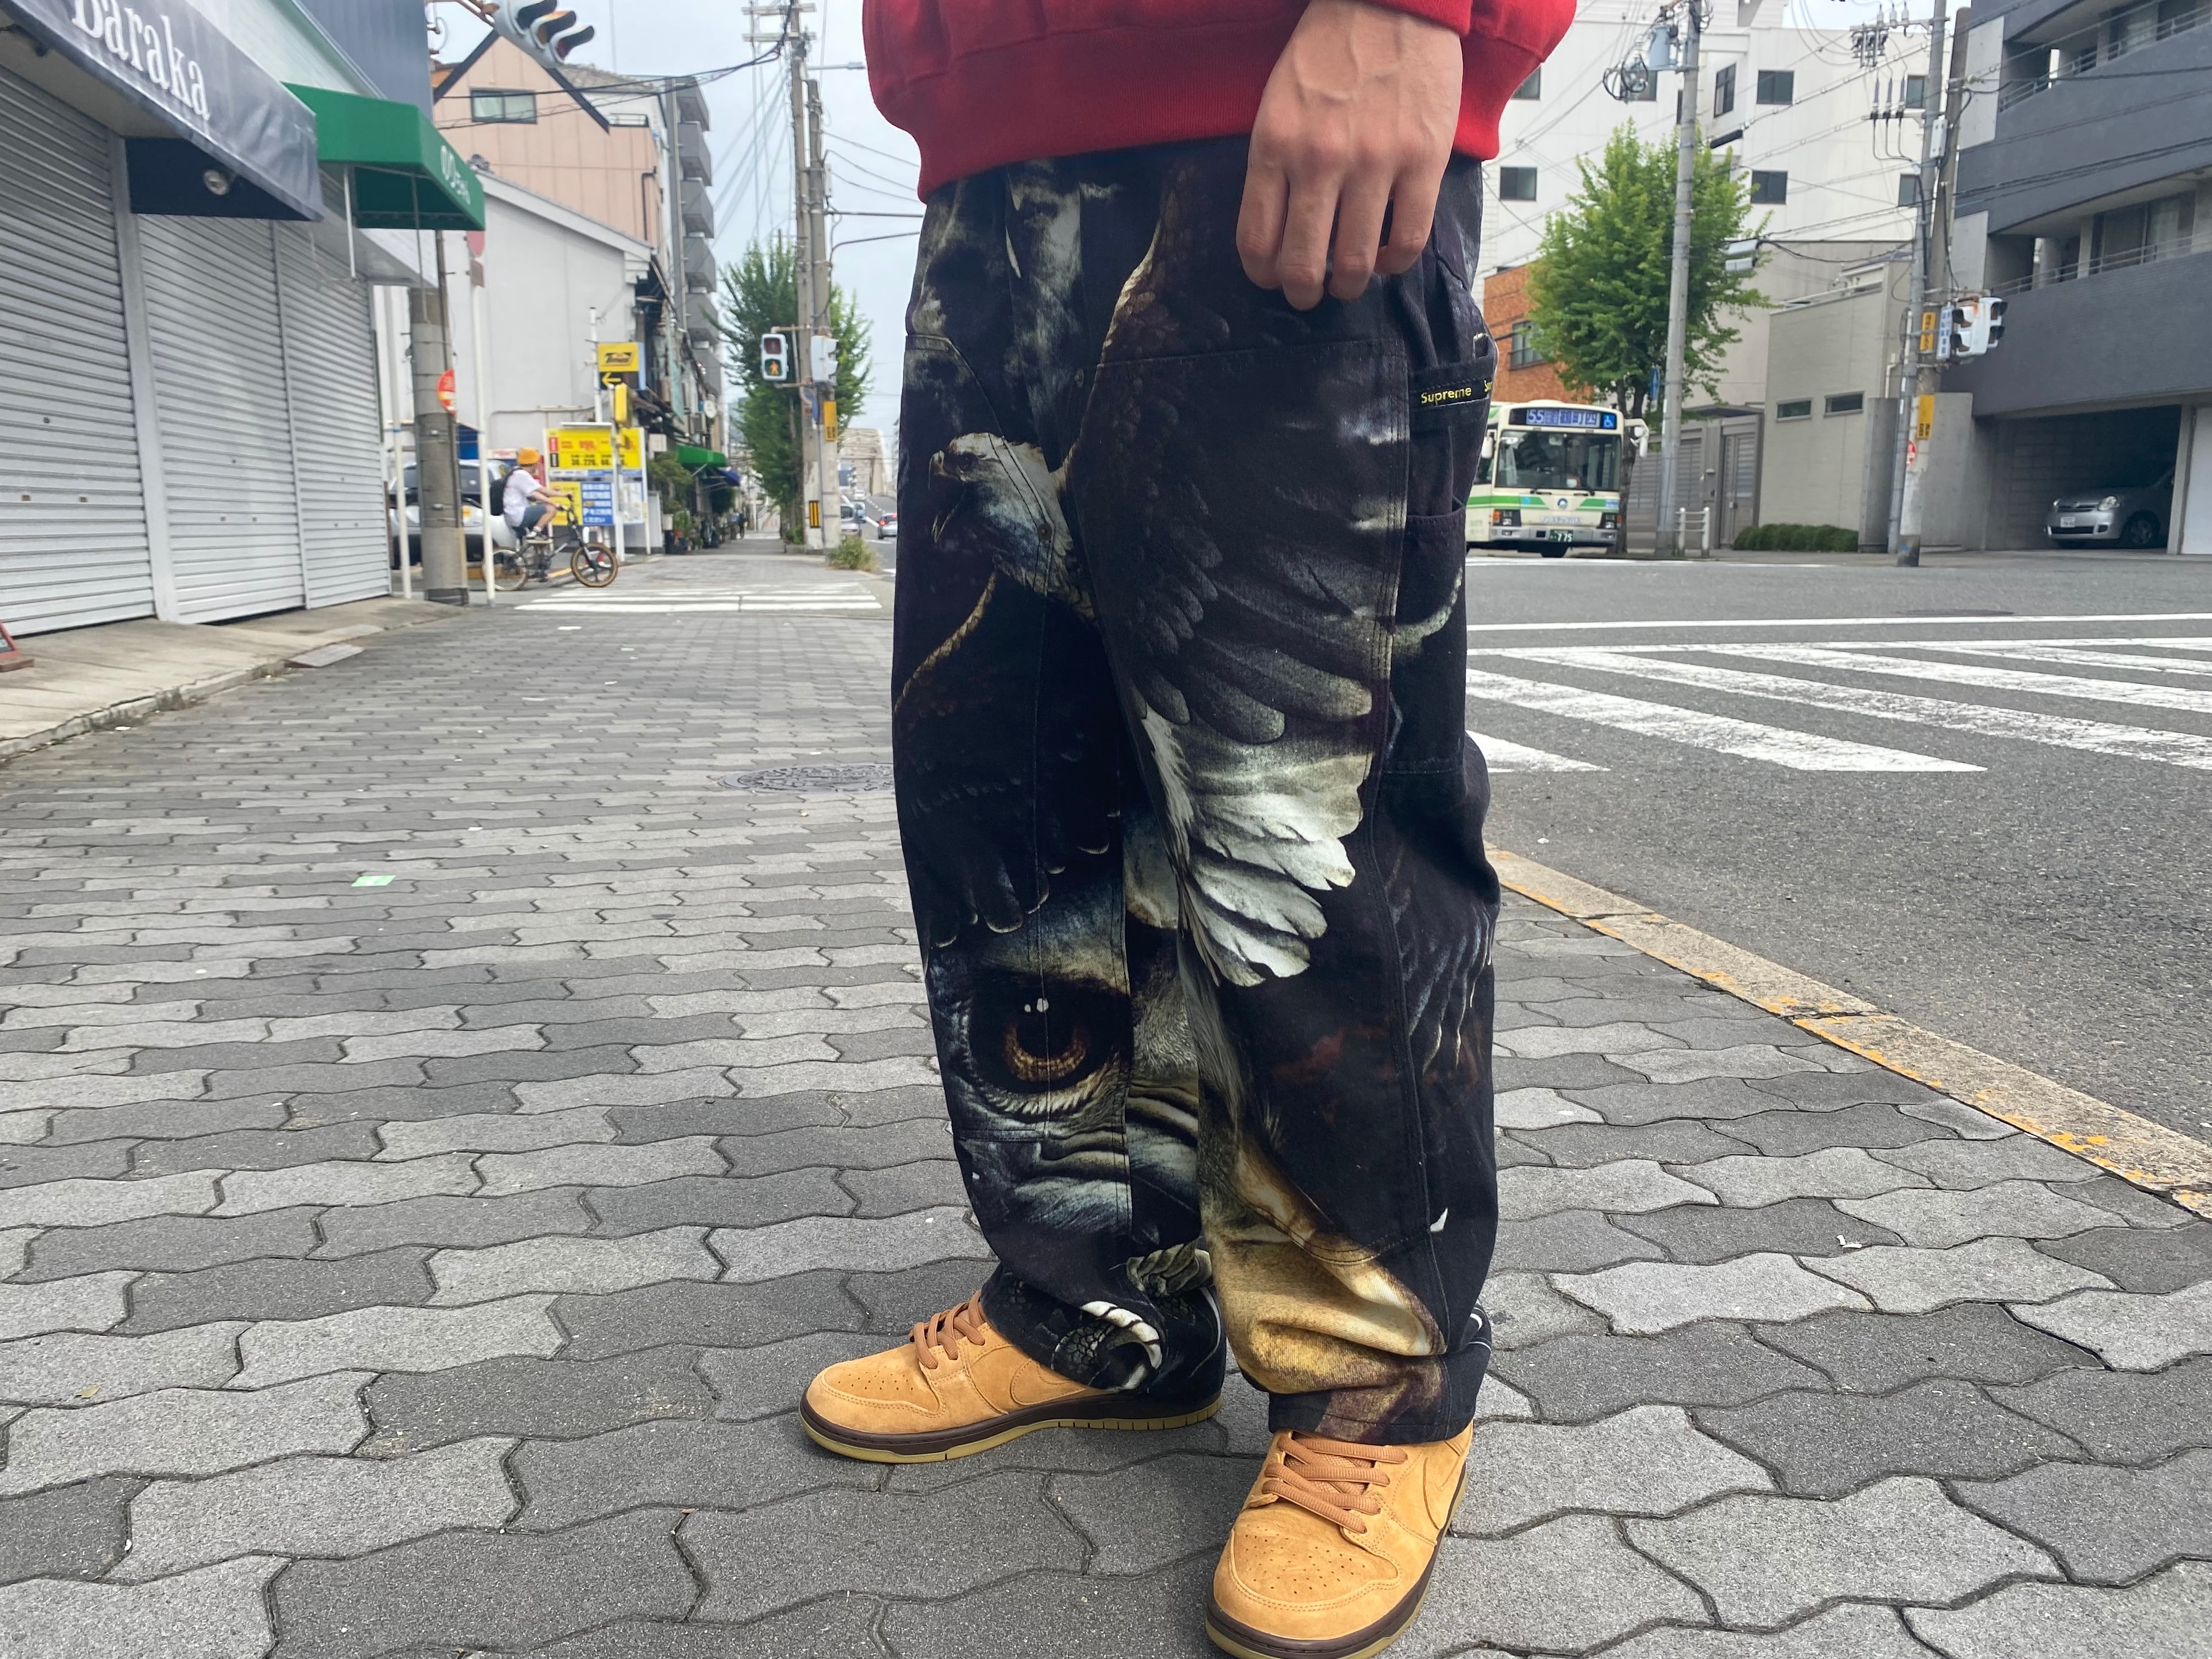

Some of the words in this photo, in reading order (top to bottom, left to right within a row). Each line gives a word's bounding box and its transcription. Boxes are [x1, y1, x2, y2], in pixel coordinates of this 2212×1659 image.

[1421, 387, 1472, 405] Supreme
[1527, 409, 1544, 424] 55
[1557, 533, 1573, 543] 775
